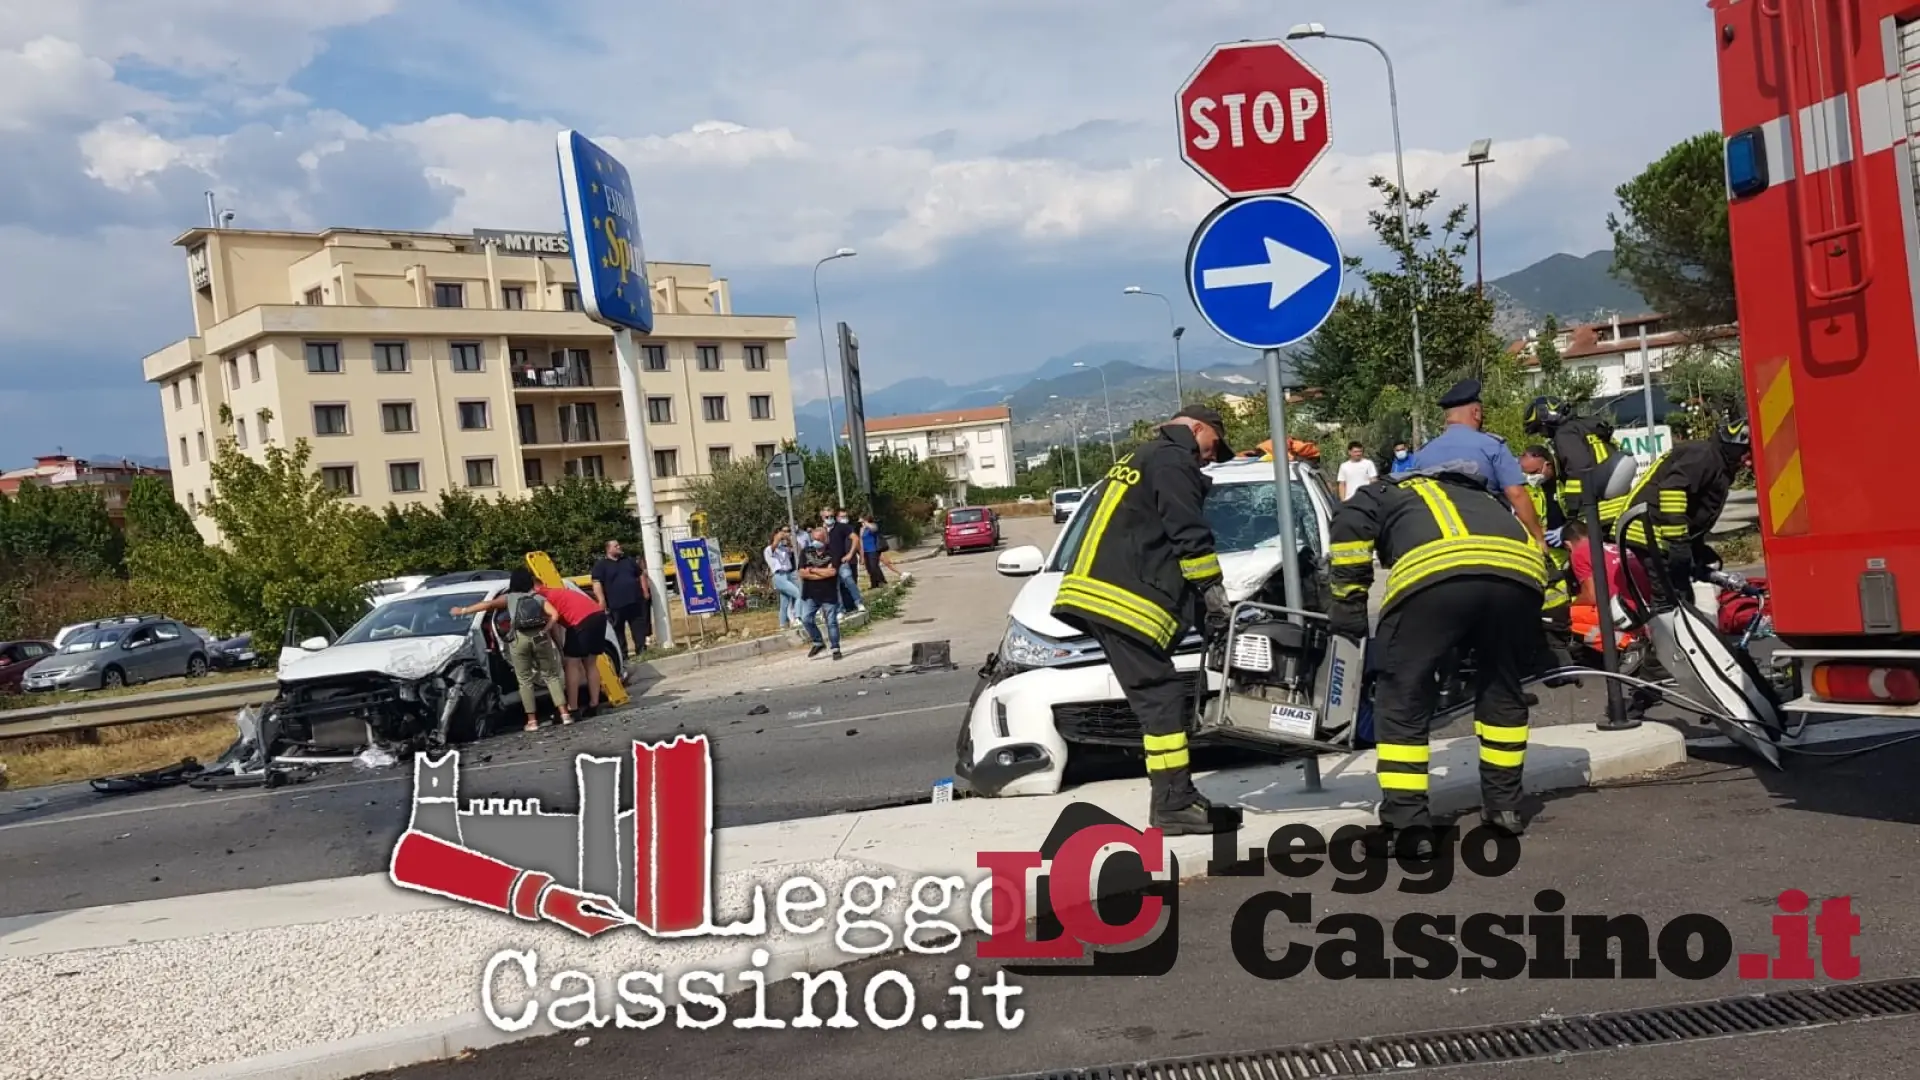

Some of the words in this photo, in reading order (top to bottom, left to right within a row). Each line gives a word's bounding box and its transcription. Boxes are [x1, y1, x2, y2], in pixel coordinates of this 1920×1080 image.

[1190, 88, 1319, 150] STOP
[1330, 657, 1346, 707] LUKAS
[1271, 707, 1313, 722] LUKAS
